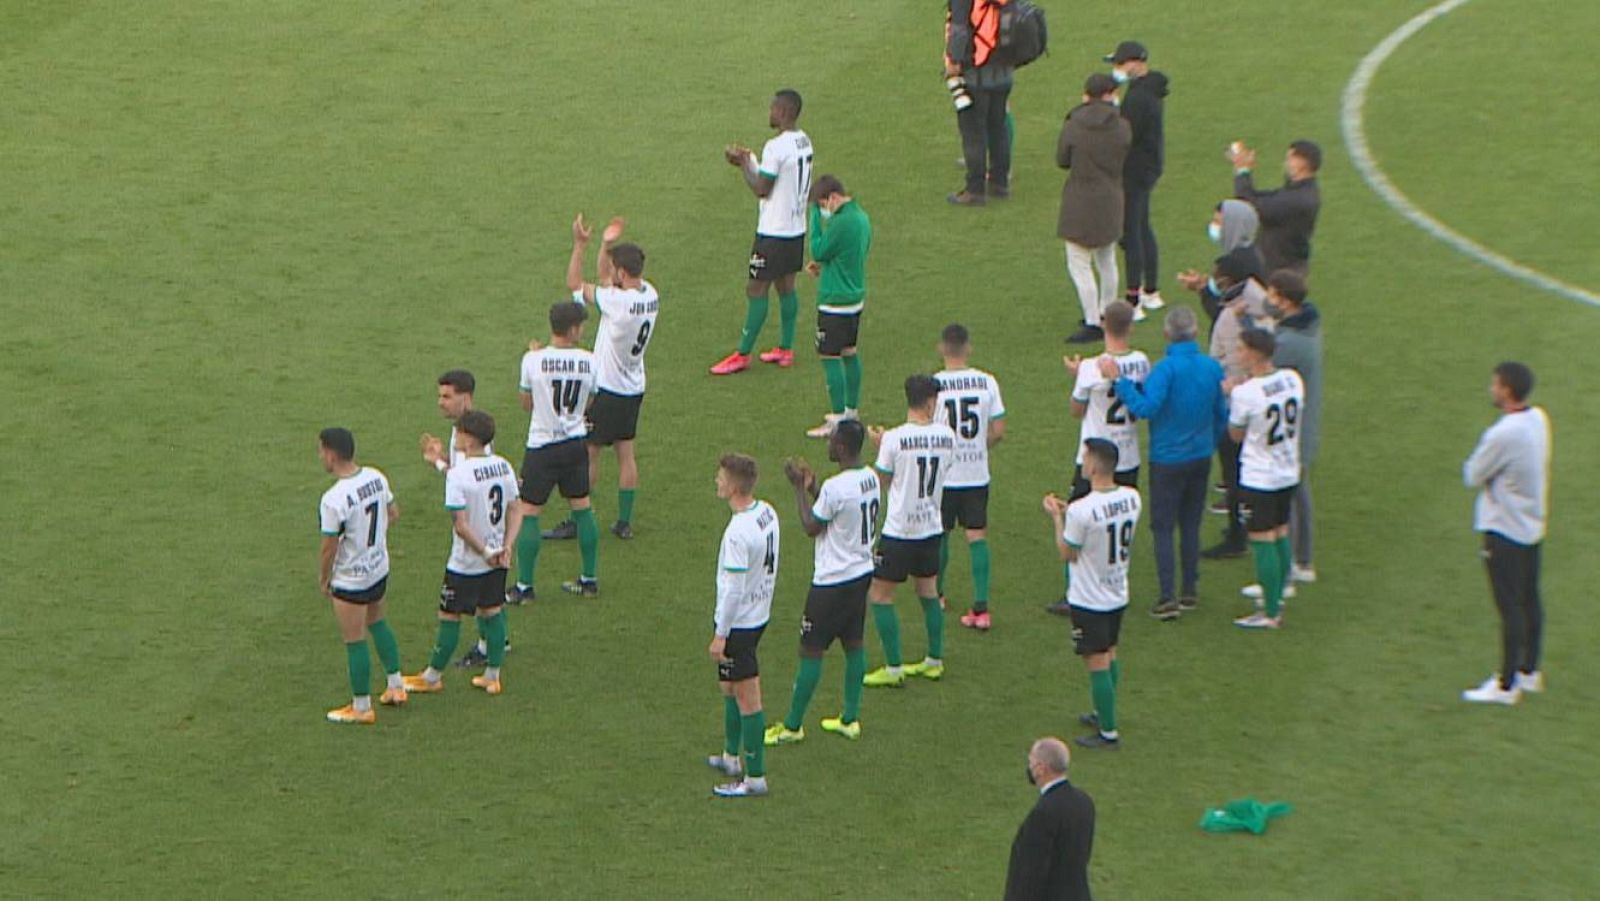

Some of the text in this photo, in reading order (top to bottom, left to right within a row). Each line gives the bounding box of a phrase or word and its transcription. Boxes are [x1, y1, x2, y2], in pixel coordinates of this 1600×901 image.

[797, 154, 813, 197] 17
[632, 320, 650, 356] 9
[552, 379, 582, 416] 14
[944, 397, 979, 439] 15
[900, 436, 928, 450] MARCO
[1267, 397, 1298, 446] 29
[365, 500, 379, 547] 7
[488, 485, 503, 526] 3
[860, 498, 879, 545] 18
[764, 532, 774, 575] 4
[1106, 520, 1133, 565] 19
